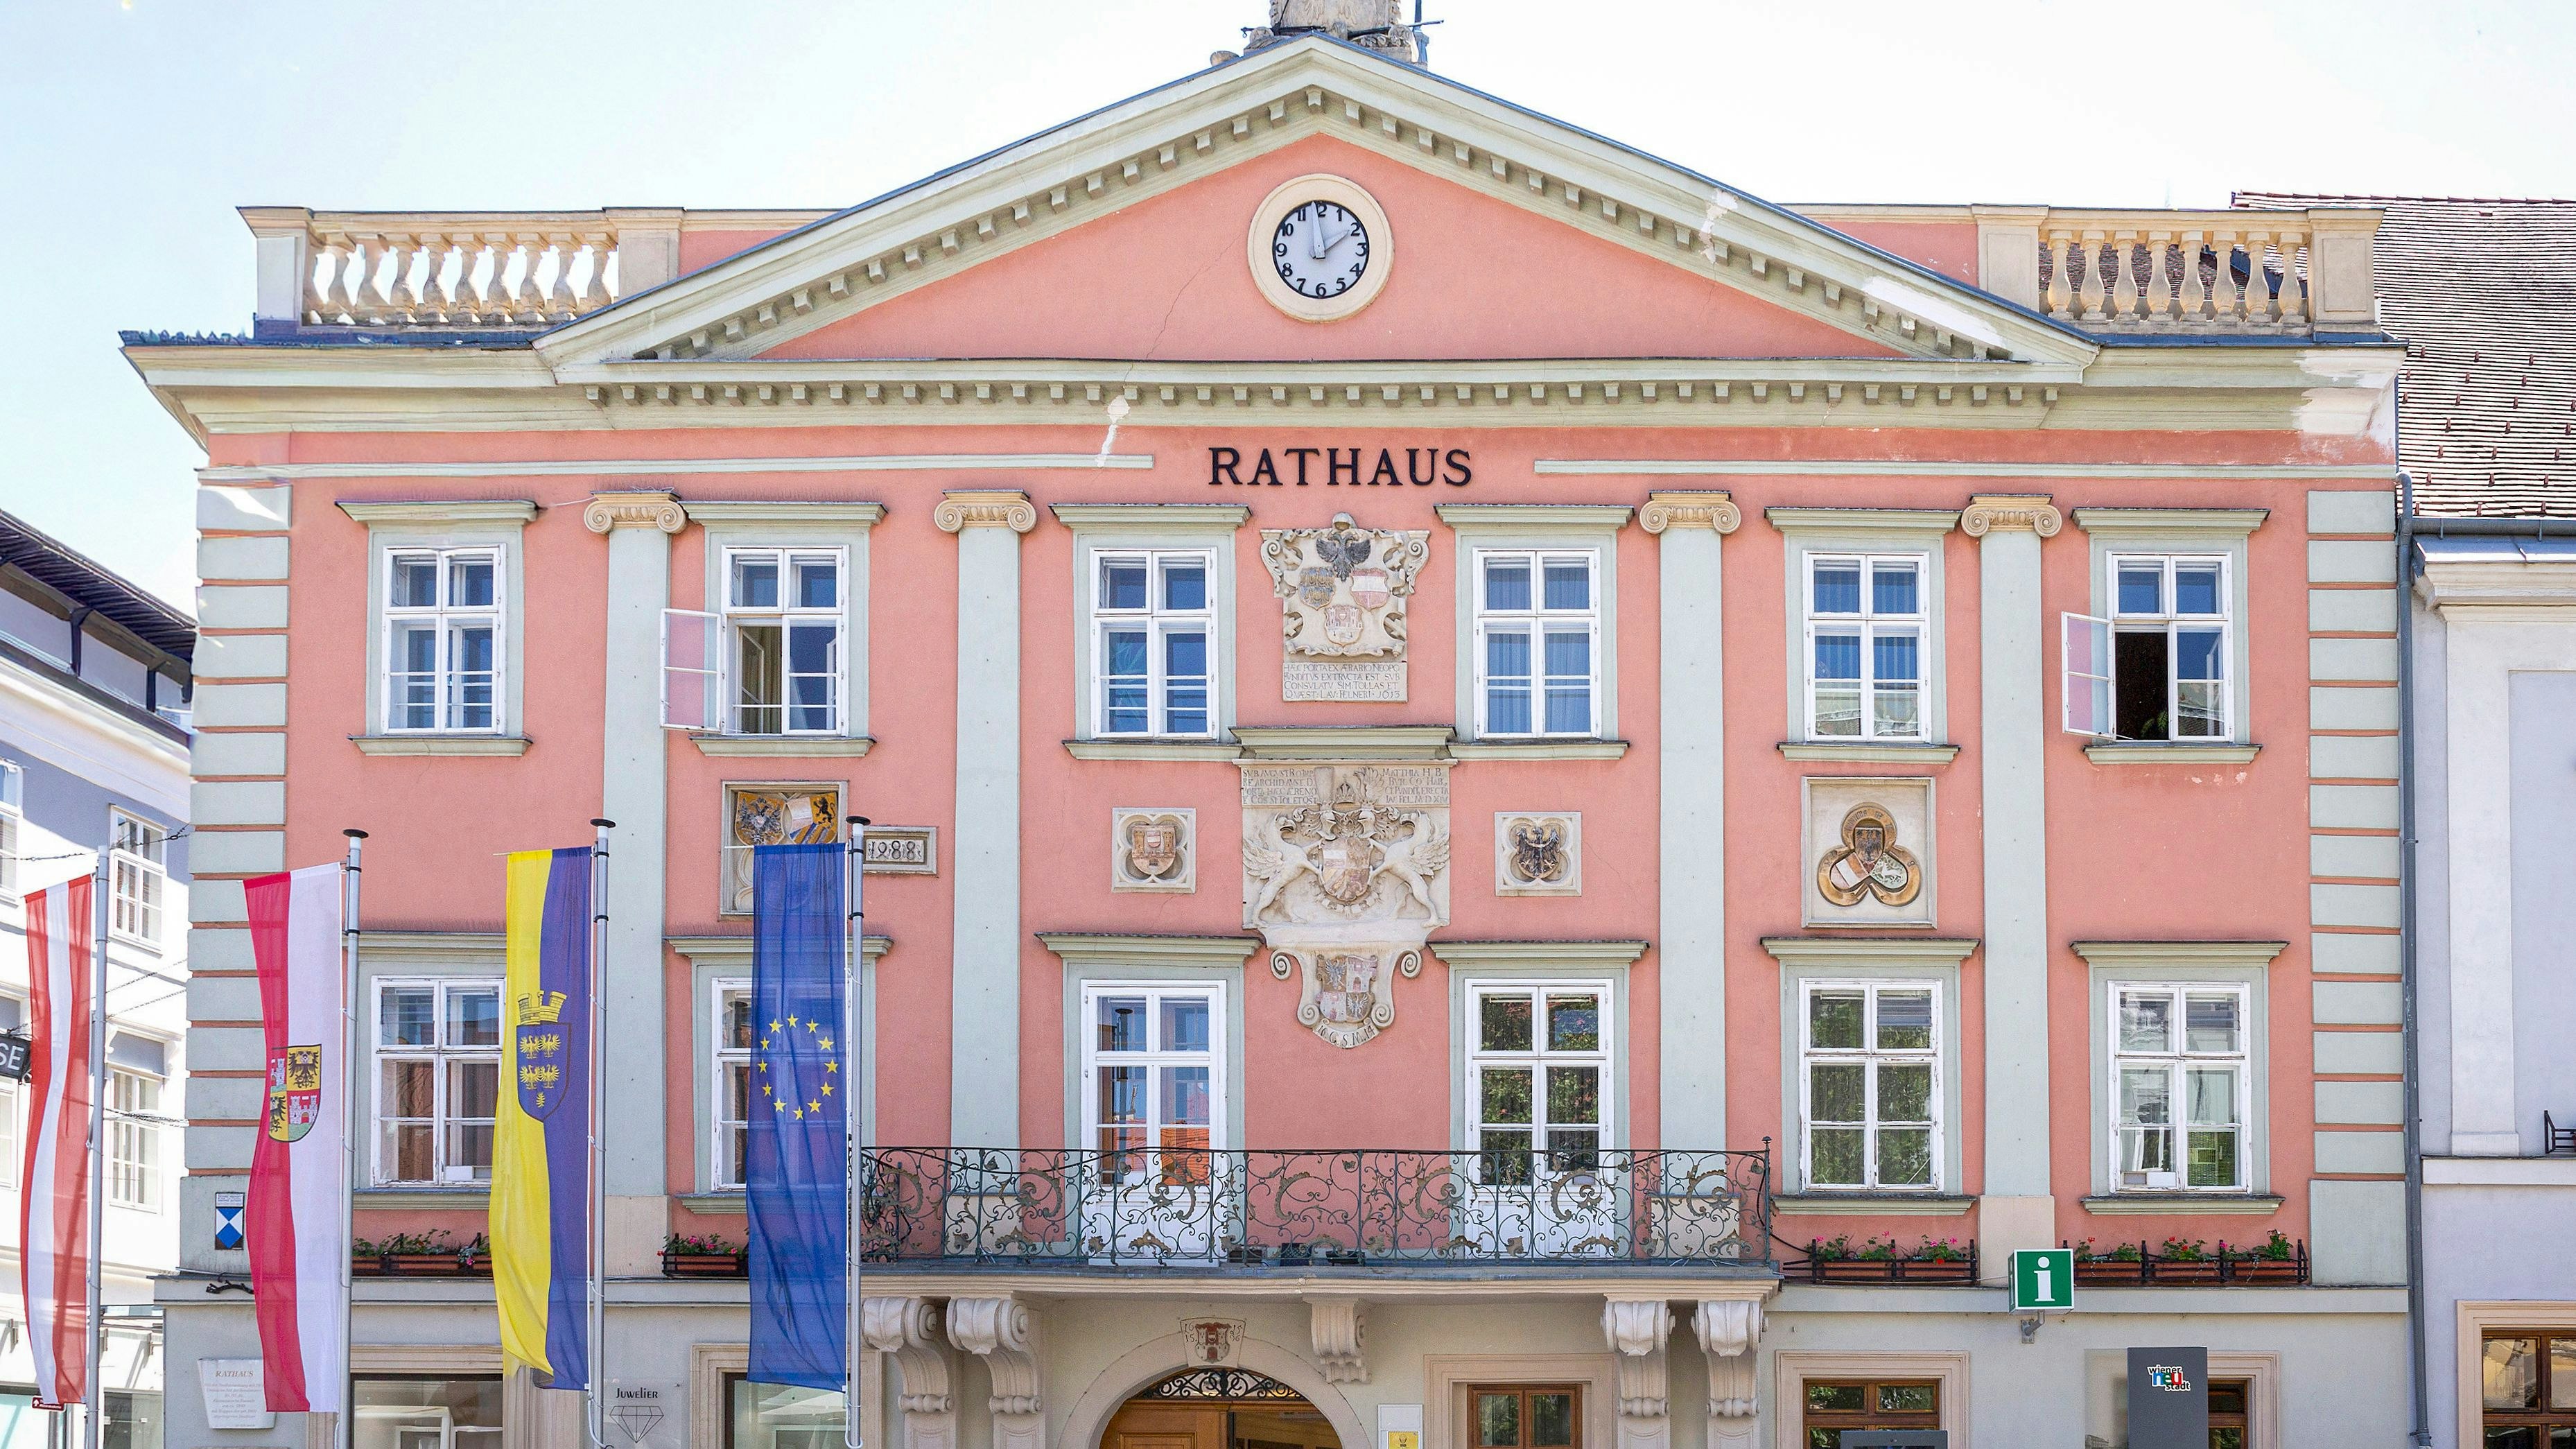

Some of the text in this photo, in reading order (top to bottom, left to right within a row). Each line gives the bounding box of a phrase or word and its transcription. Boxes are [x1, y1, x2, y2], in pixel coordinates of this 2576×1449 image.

[1296, 209, 1306, 222] 11
[1336, 208, 1343, 222] 1
[1282, 223, 1294, 236] 10
[1350, 223, 1361, 236] 2
[1276, 243, 1287, 257] 9
[1355, 243, 1368, 257] 3
[1282, 262, 1293, 277] 8
[1350, 263, 1362, 277] 4
[1297, 278, 1307, 293] 7
[1316, 282, 1327, 297] 6
[1336, 277, 1347, 291] 5
[1208, 447, 1472, 486] RATHAUS
[2148, 1365, 2181, 1373] wiener
[2152, 1372, 2182, 1386] neu
[2166, 1382, 2190, 1390] stadt
